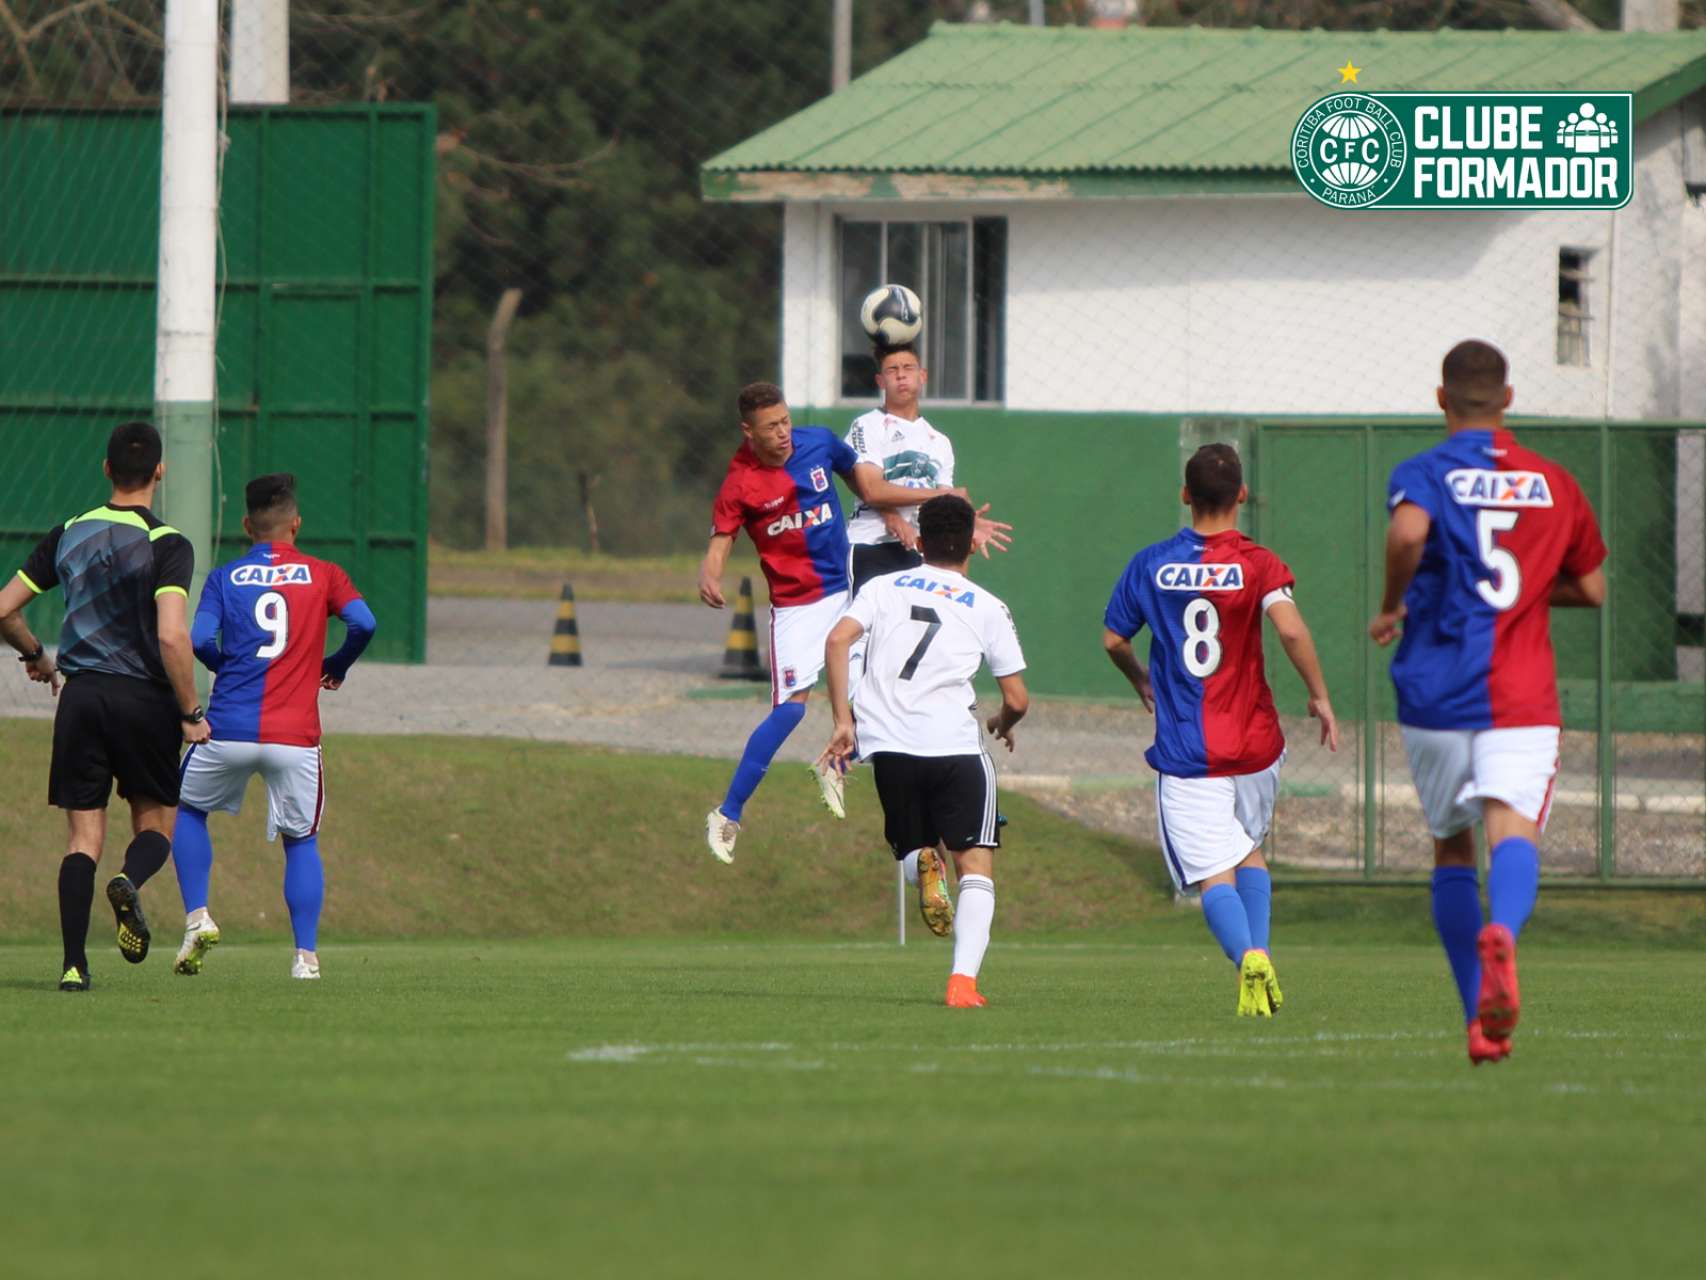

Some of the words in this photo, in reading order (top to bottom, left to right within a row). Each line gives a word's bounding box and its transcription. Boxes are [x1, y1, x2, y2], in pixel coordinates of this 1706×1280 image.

[1452, 475, 1547, 502] CAIXA
[767, 502, 833, 536] CAIXA
[233, 566, 308, 583] CAIXA
[1475, 509, 1521, 610] 5
[893, 574, 975, 608] CAIXA
[1159, 567, 1241, 587] CAIXA
[255, 591, 289, 659] 9
[1183, 598, 1221, 678] 8
[898, 605, 942, 681] 7
